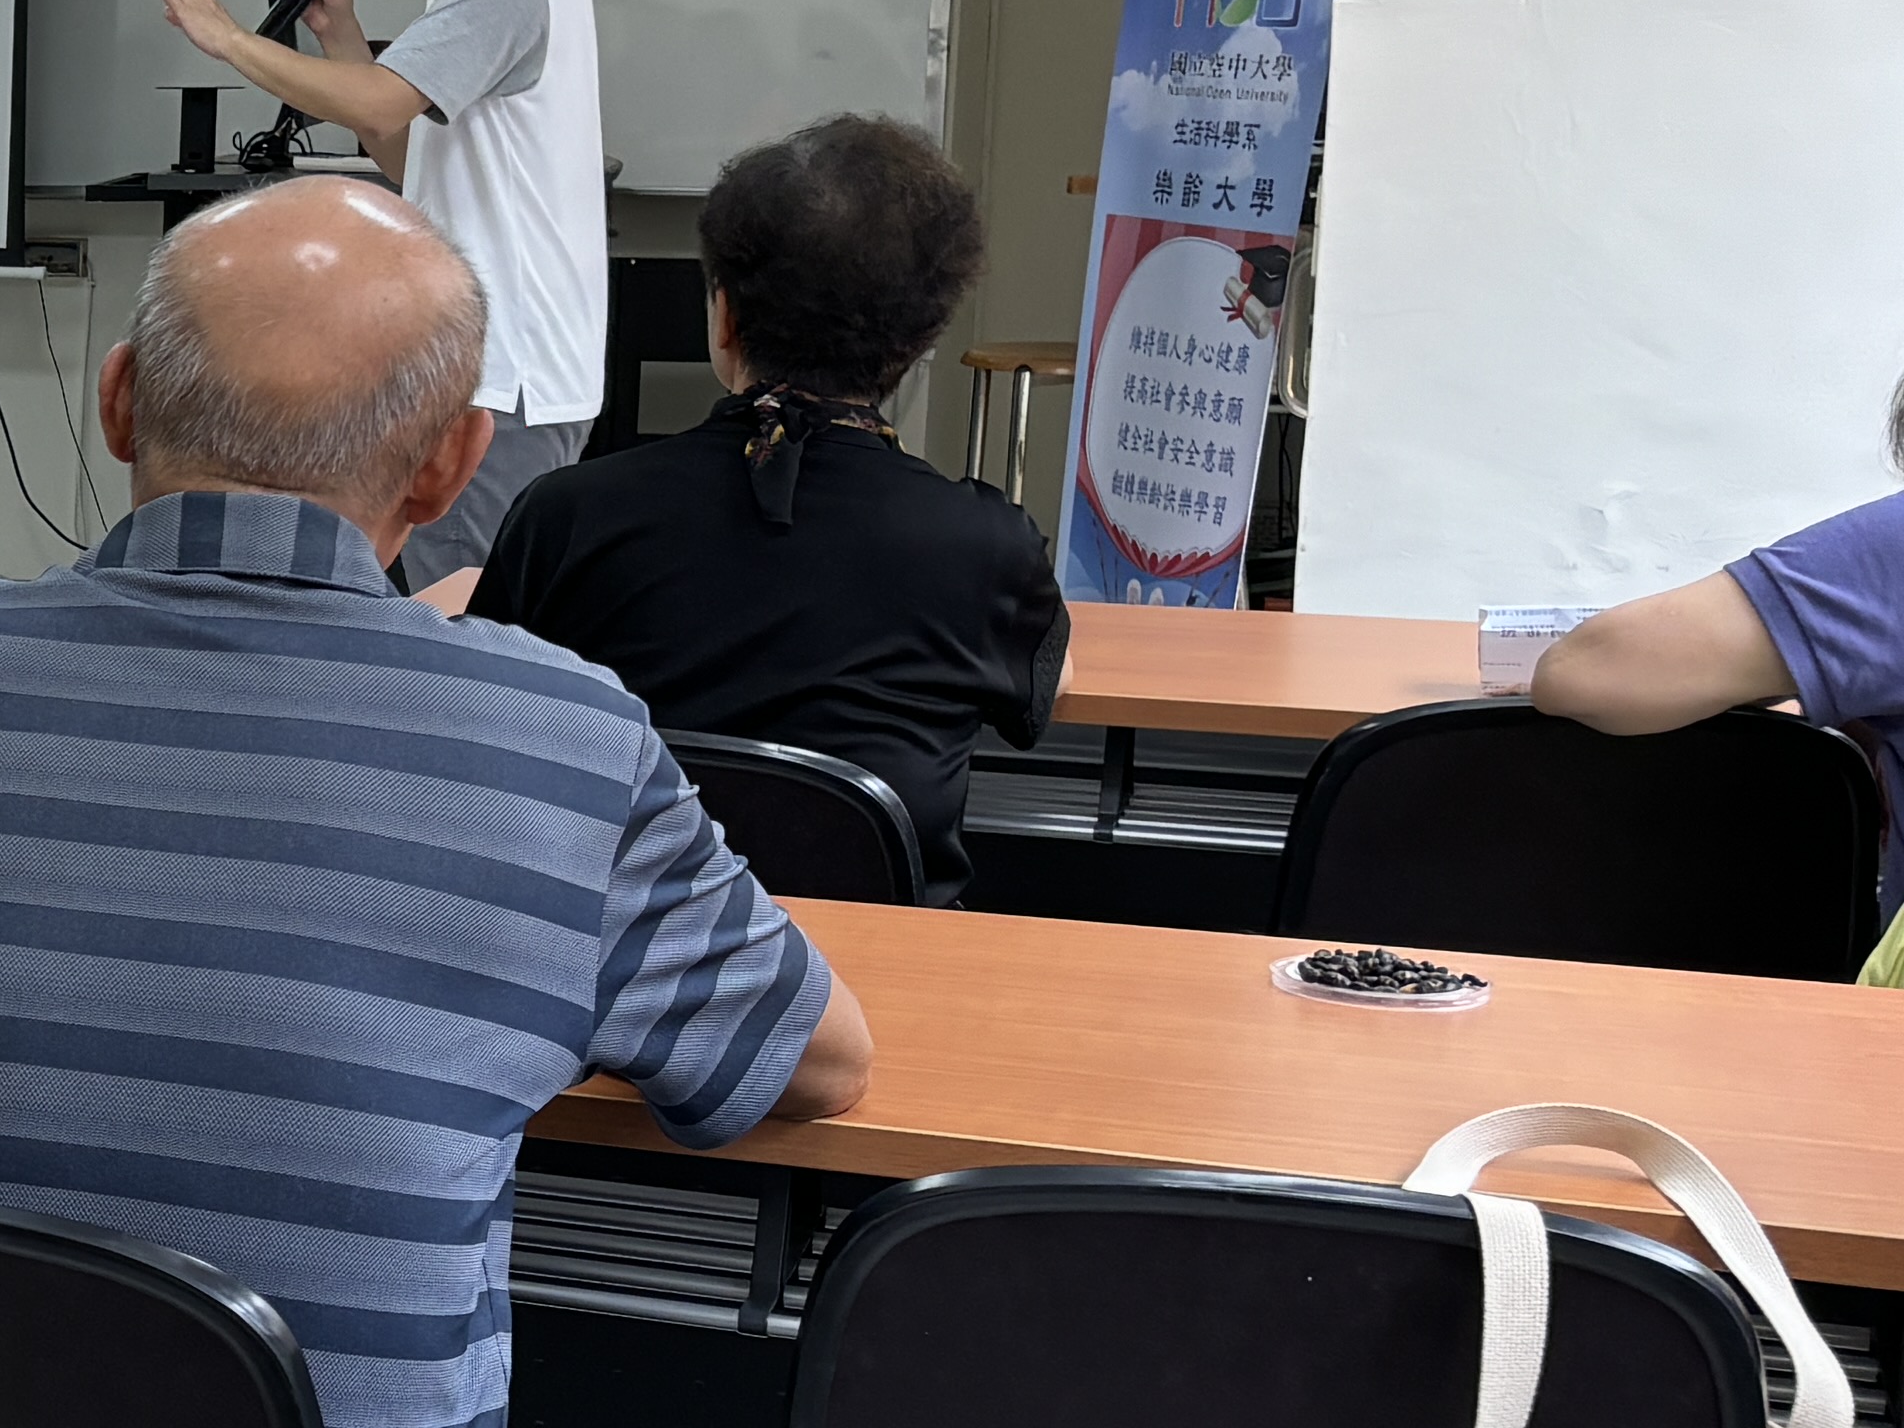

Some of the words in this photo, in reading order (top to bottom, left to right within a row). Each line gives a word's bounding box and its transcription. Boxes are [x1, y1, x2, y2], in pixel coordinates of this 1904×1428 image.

[1169, 51, 1293, 82] 國立空中大學
[1168, 83, 1205, 98] National
[1206, 86, 1232, 101] Open
[1236, 87, 1289, 105] University
[1172, 119, 1261, 151] 生活科學系
[1152, 168, 1274, 218] 樂齡大學
[1129, 325, 1250, 375] 維持個人身心健康
[1123, 372, 1244, 426] 提高社會參與意願
[1117, 421, 1236, 477] 健全社會安全意識
